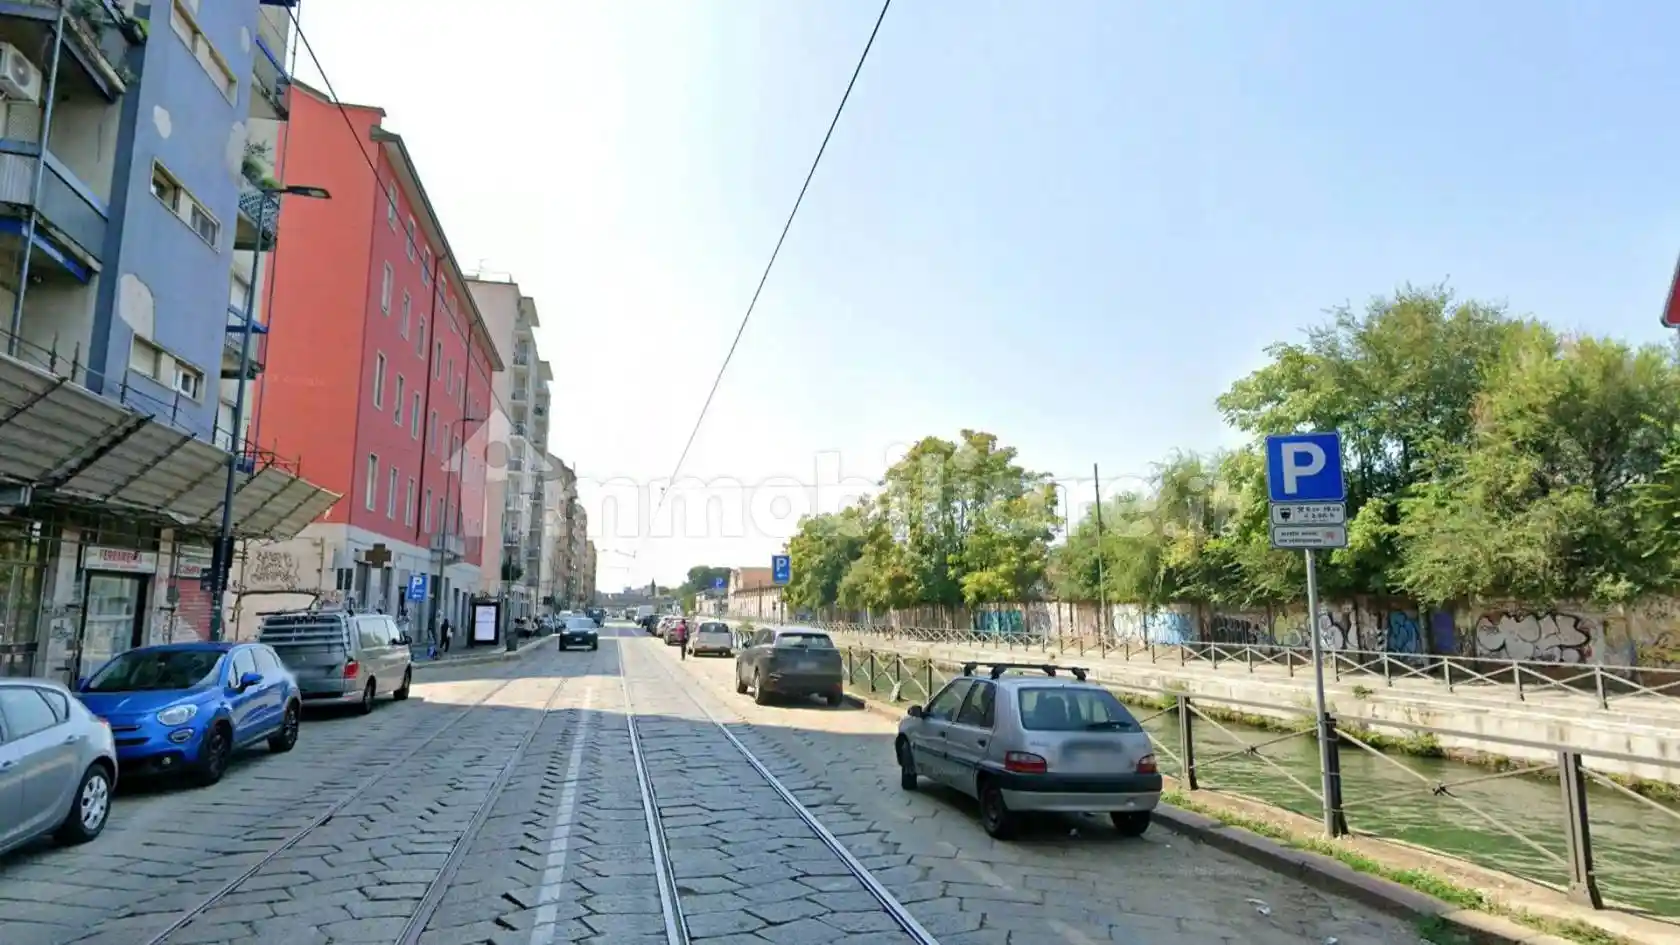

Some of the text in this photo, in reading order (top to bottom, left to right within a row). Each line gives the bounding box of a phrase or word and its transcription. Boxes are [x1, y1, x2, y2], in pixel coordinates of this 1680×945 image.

[1281, 442, 1326, 494] P
[776, 558, 787, 572] P
[412, 577, 423, 590] P
